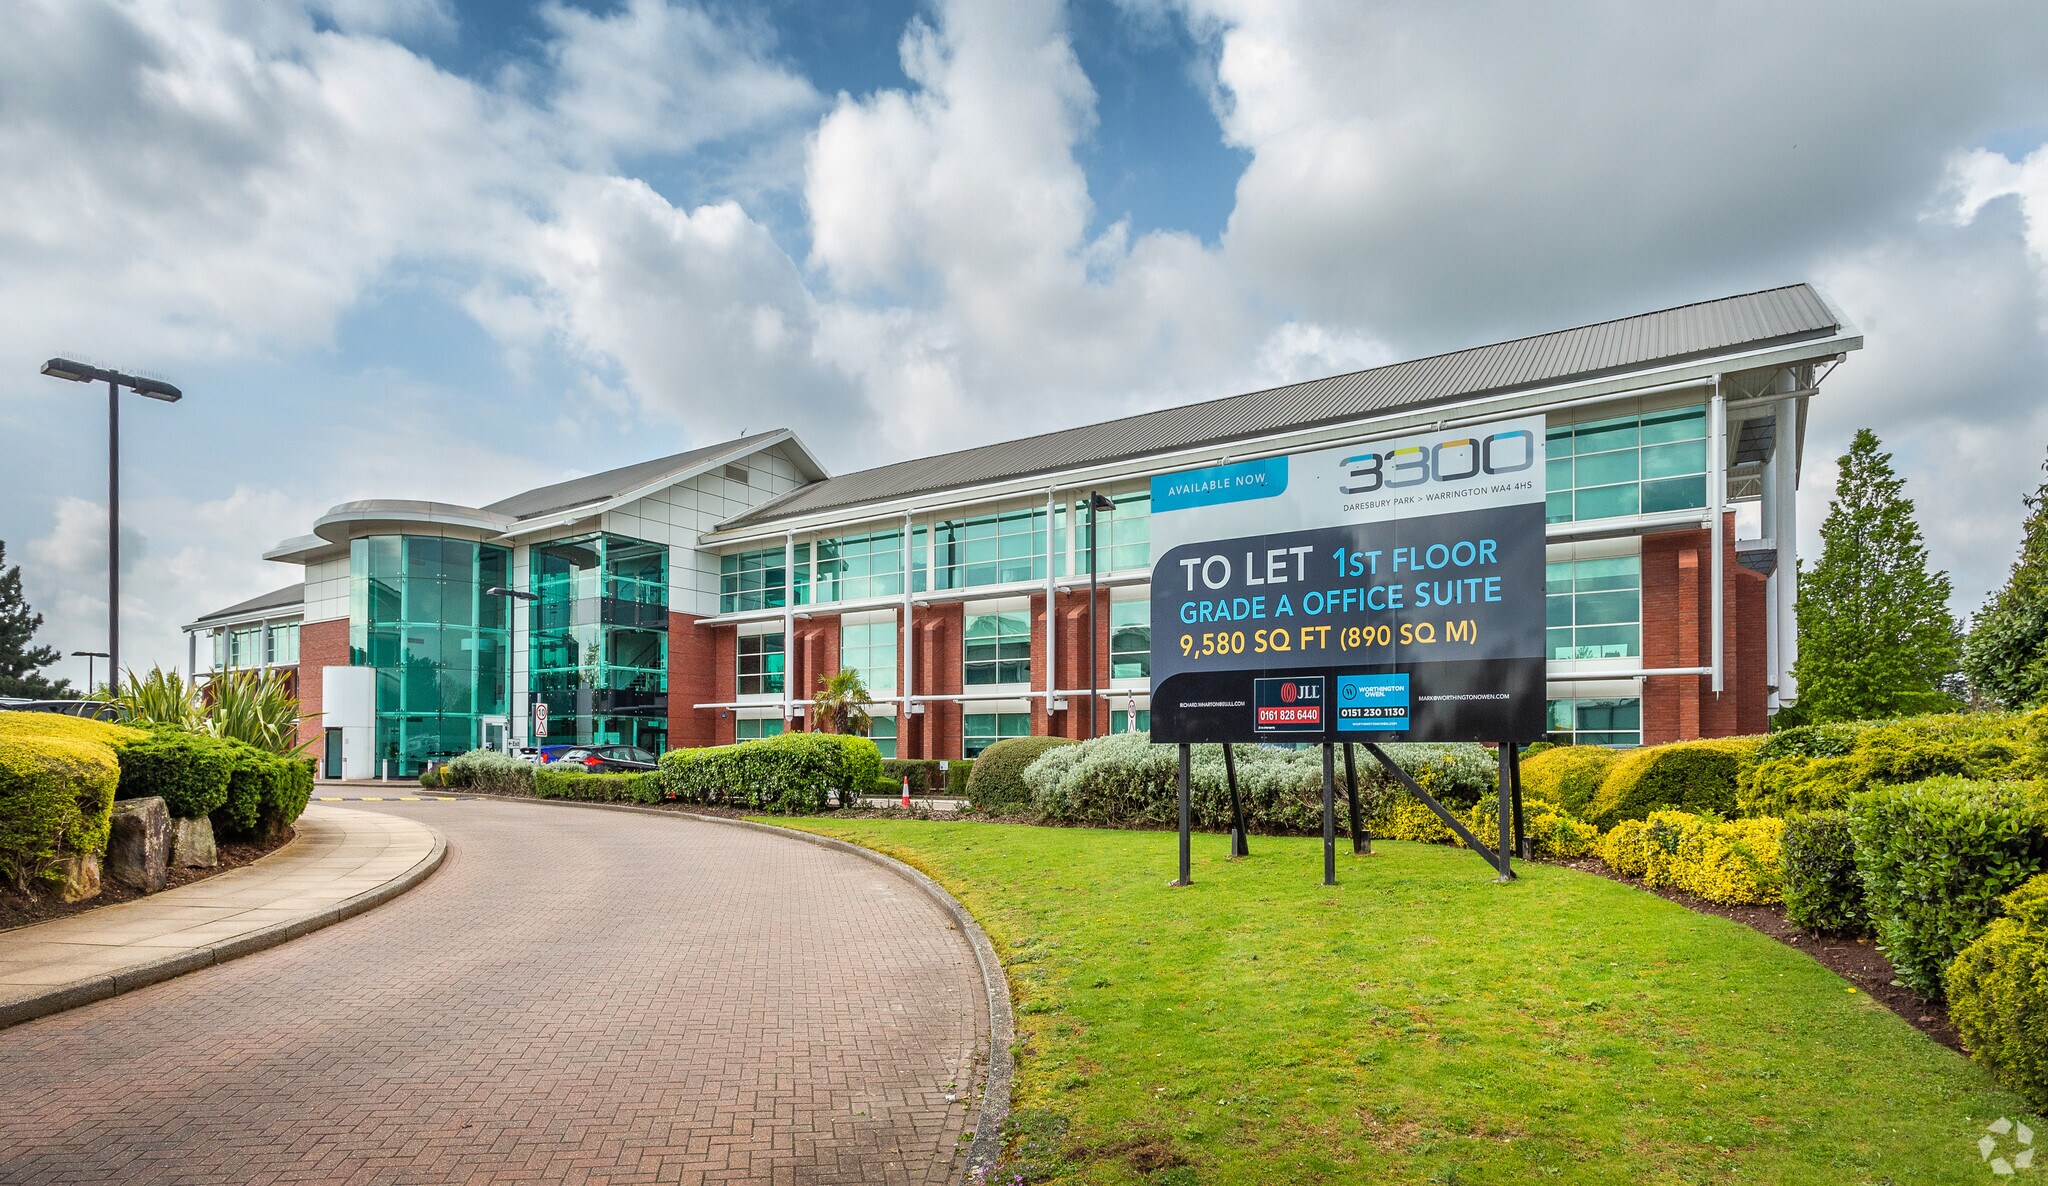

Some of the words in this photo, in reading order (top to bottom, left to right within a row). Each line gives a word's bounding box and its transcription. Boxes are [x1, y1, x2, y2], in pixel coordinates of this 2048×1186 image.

[1339, 430, 1534, 494] 3300
[1168, 478, 1230, 496] AVAILABLE
[1236, 473, 1266, 486] NOW
[1343, 499, 1391, 512] DARESBURY
[1393, 496, 1415, 506] PARK
[1425, 487, 1488, 502] WARRINGTON
[1491, 483, 1512, 493] WA4
[1514, 481, 1532, 490] 4HS
[1179, 554, 1232, 592] TO
[1246, 545, 1314, 586] LET
[1332, 547, 1383, 578] 1ST
[1393, 539, 1498, 573] FLOOR
[1179, 595, 1266, 624] GRADE
[1274, 594, 1294, 618] A
[1302, 584, 1404, 616] OFFICE
[1414, 576, 1502, 608] SUITE
[1179, 630, 1245, 660] 9,580
[1254, 627, 1291, 653] SQ
[1300, 625, 1332, 651] FT
[1340, 624, 1391, 652] (890
[1399, 622, 1437, 646] SQ
[1446, 619, 1478, 646] M)
[1297, 685, 1320, 699] JLL
[1358, 685, 1405, 693] WORTHINGTON
[538, 708, 545, 716] 10
[1260, 710, 1278, 721] 0161
[1279, 709, 1295, 720] 828
[1297, 709, 1318, 720] 6440
[1341, 708, 1361, 717] 0151
[1363, 708, 1382, 717] 230
[1384, 707, 1405, 716] 1130
